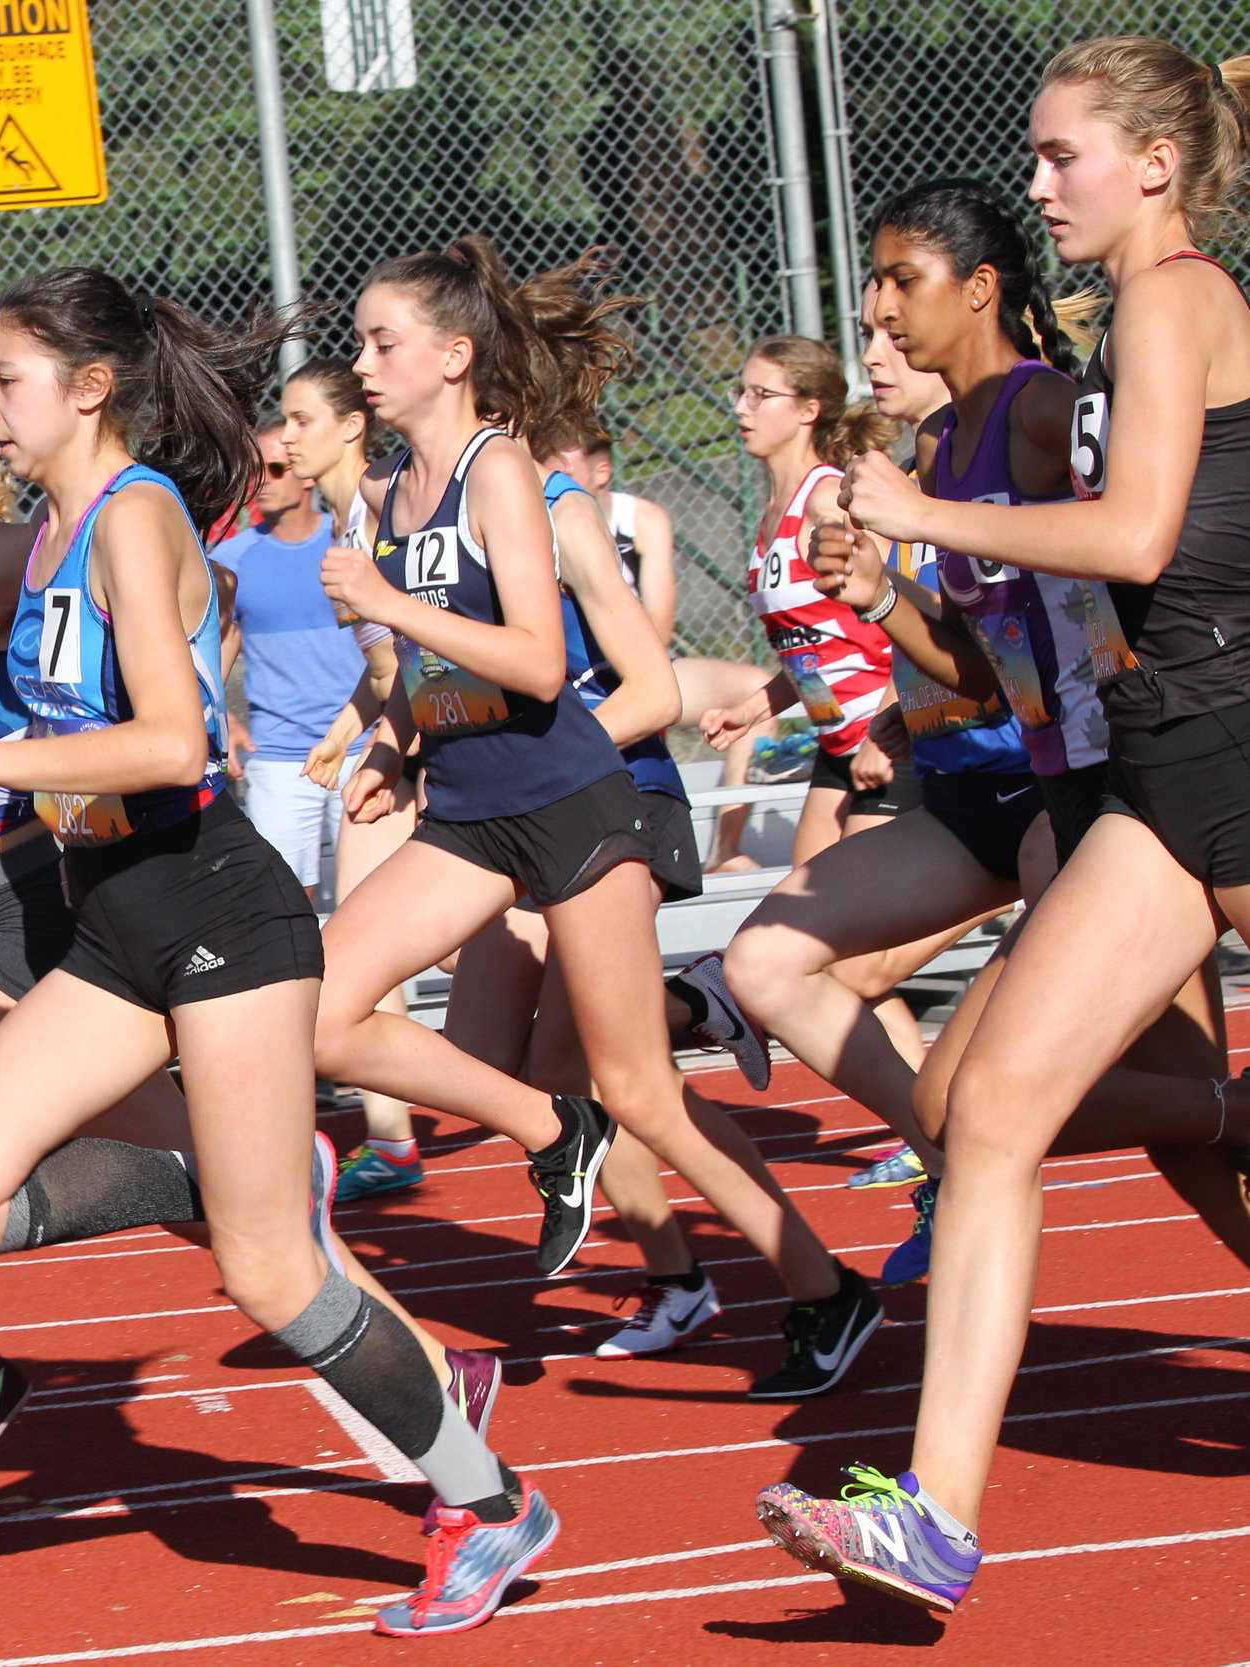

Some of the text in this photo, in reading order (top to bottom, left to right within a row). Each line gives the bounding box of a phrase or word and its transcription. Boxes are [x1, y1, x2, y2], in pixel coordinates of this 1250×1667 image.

[13, 65, 34, 84] BE
[1078, 401, 1104, 489] 5
[415, 532, 447, 584] 12
[762, 551, 781, 589] 19
[49, 595, 71, 677] 7
[12, 674, 82, 701] CEAN
[429, 690, 469, 726] 281
[54, 793, 94, 835] 282
[853, 1511, 909, 1562] N
